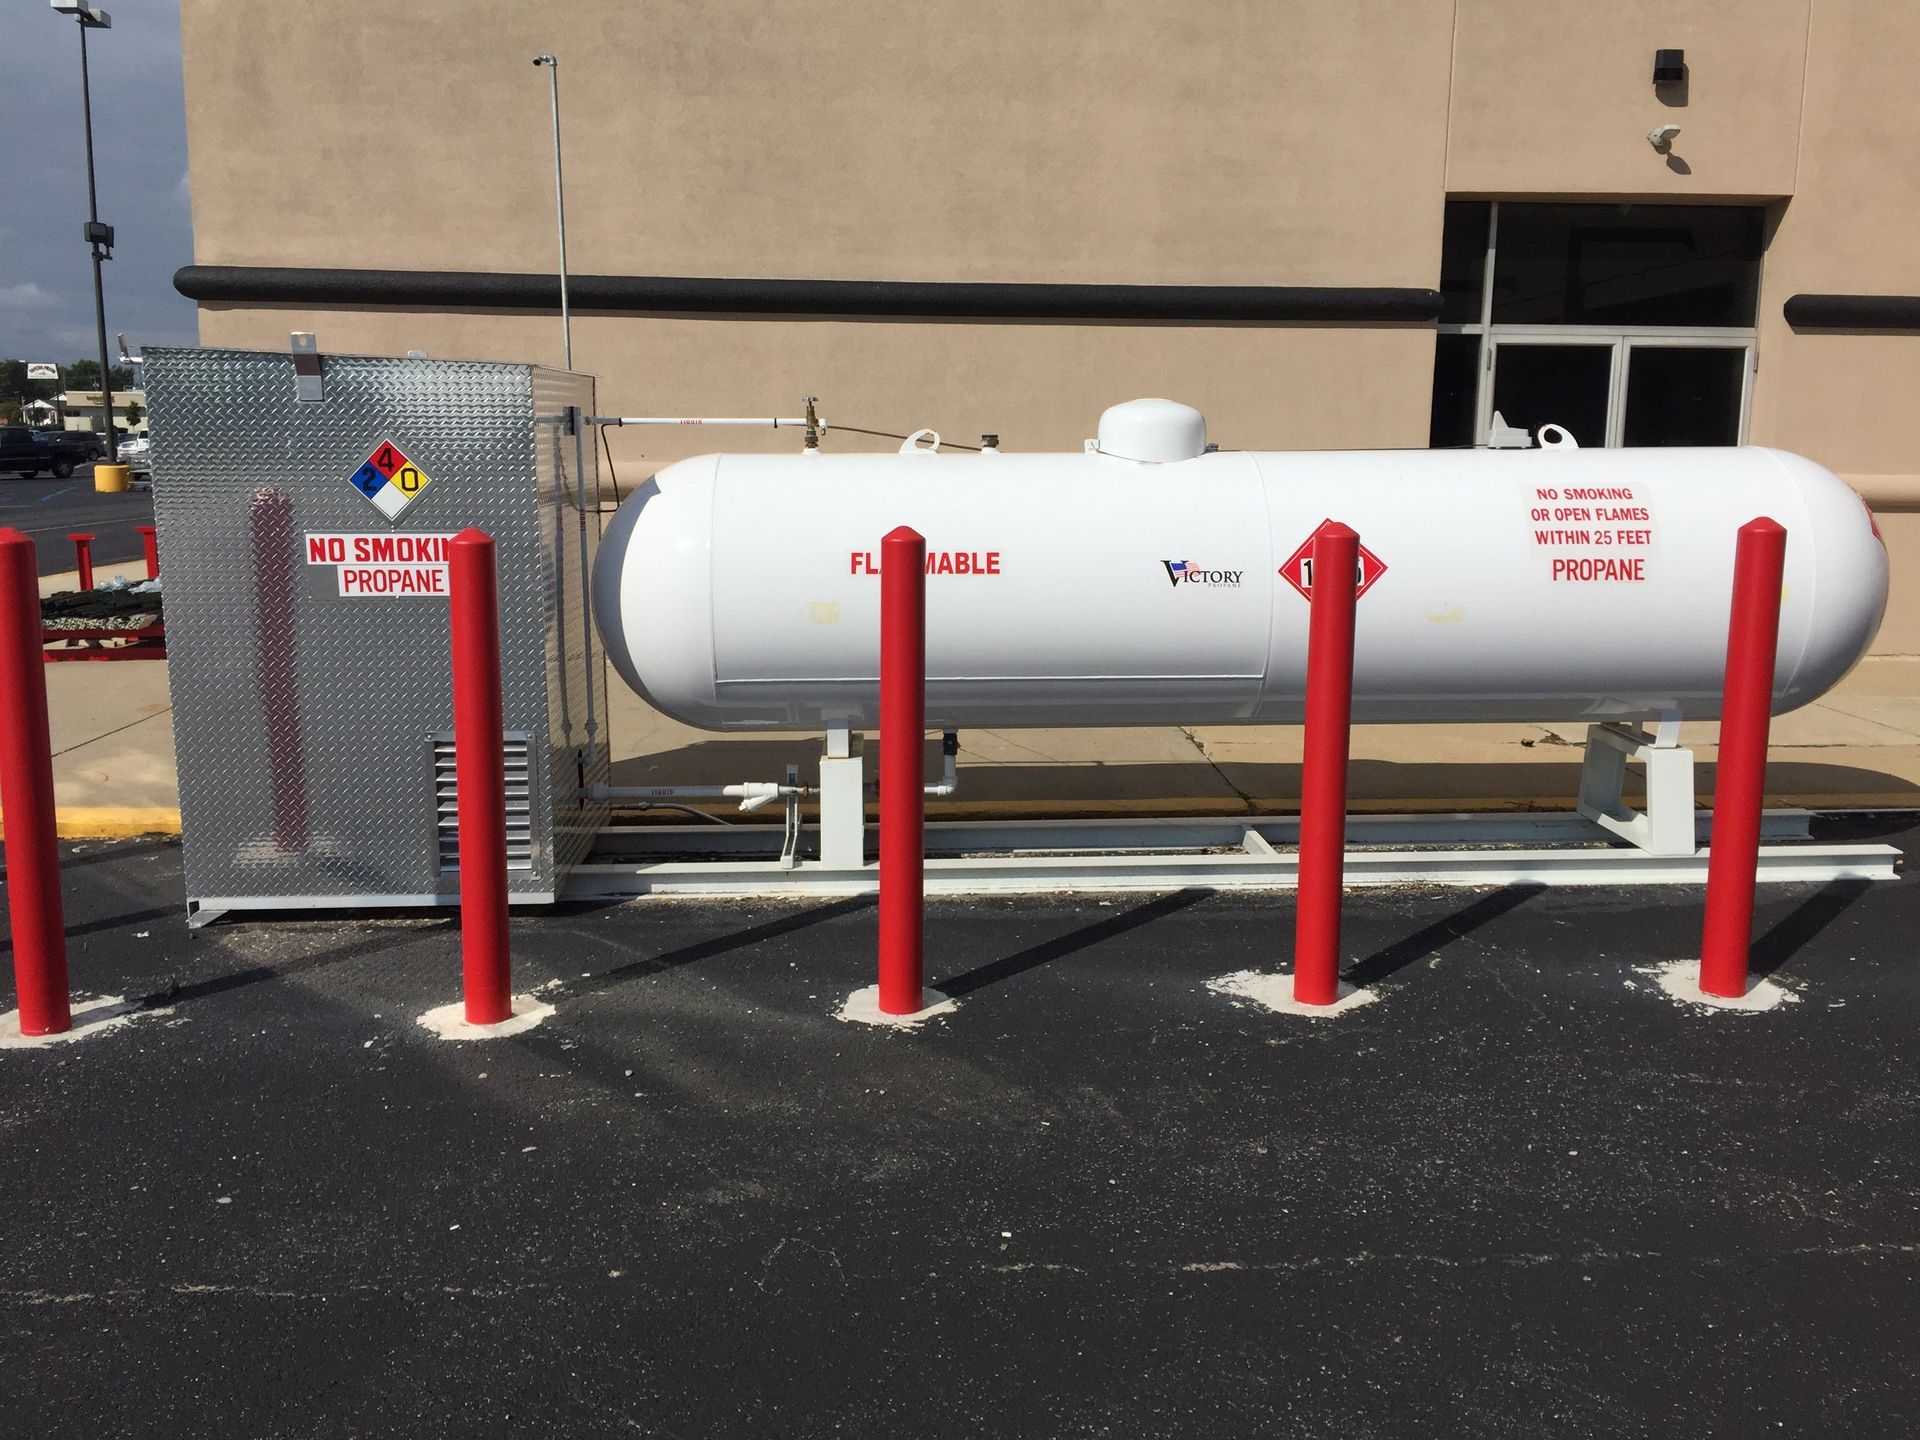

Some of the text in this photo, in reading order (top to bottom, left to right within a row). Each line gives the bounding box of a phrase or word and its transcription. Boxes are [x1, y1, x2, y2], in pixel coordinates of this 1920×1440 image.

[378, 448, 395, 472] 4
[362, 467, 377, 492] 2
[1536, 488, 1633, 500] NO SMOKING
[1531, 507, 1650, 521] OR OPEN FLAMES
[1535, 530, 1652, 545] WITHIN 25 FEET
[309, 537, 346, 562] NO
[343, 569, 445, 593] PROPANE
[1553, 559, 1645, 581] PROPANE
